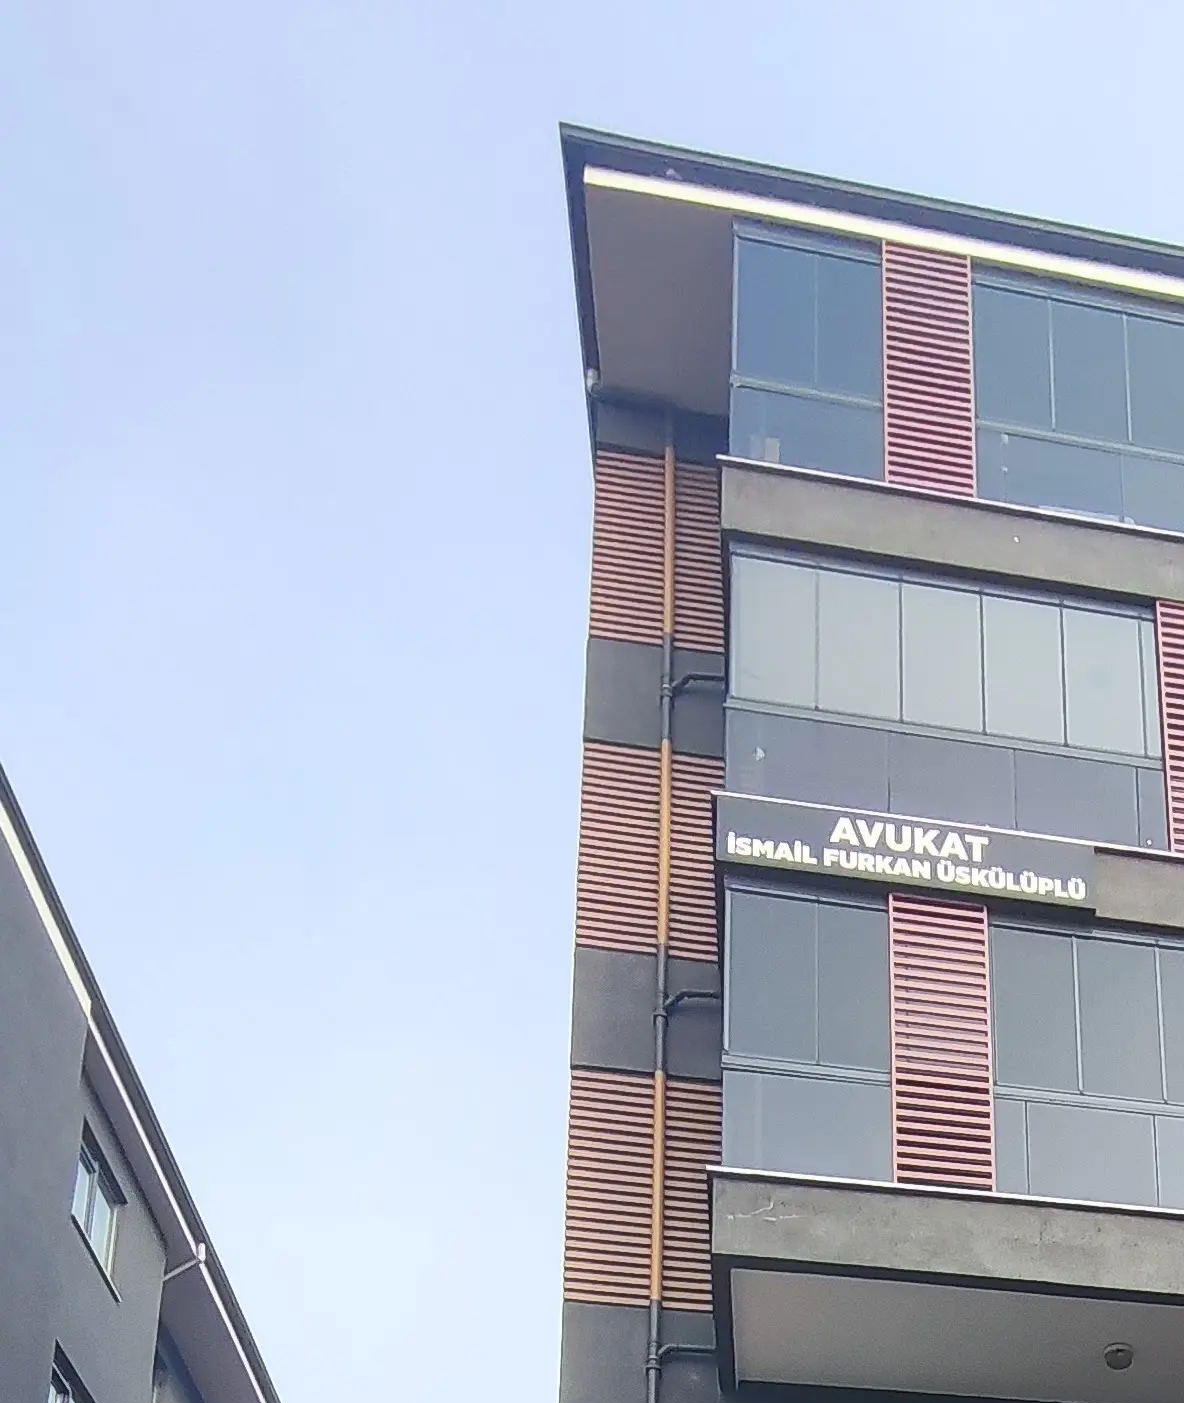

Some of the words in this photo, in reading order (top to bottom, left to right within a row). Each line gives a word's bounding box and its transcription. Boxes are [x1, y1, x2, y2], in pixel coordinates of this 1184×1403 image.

[727, 831, 818, 866] İSMAİL
[823, 846, 932, 882] FURKAN
[936, 858, 1087, 901] ÜSKÜLÜPLÜ
[829, 816, 990, 863] AVUKAT
